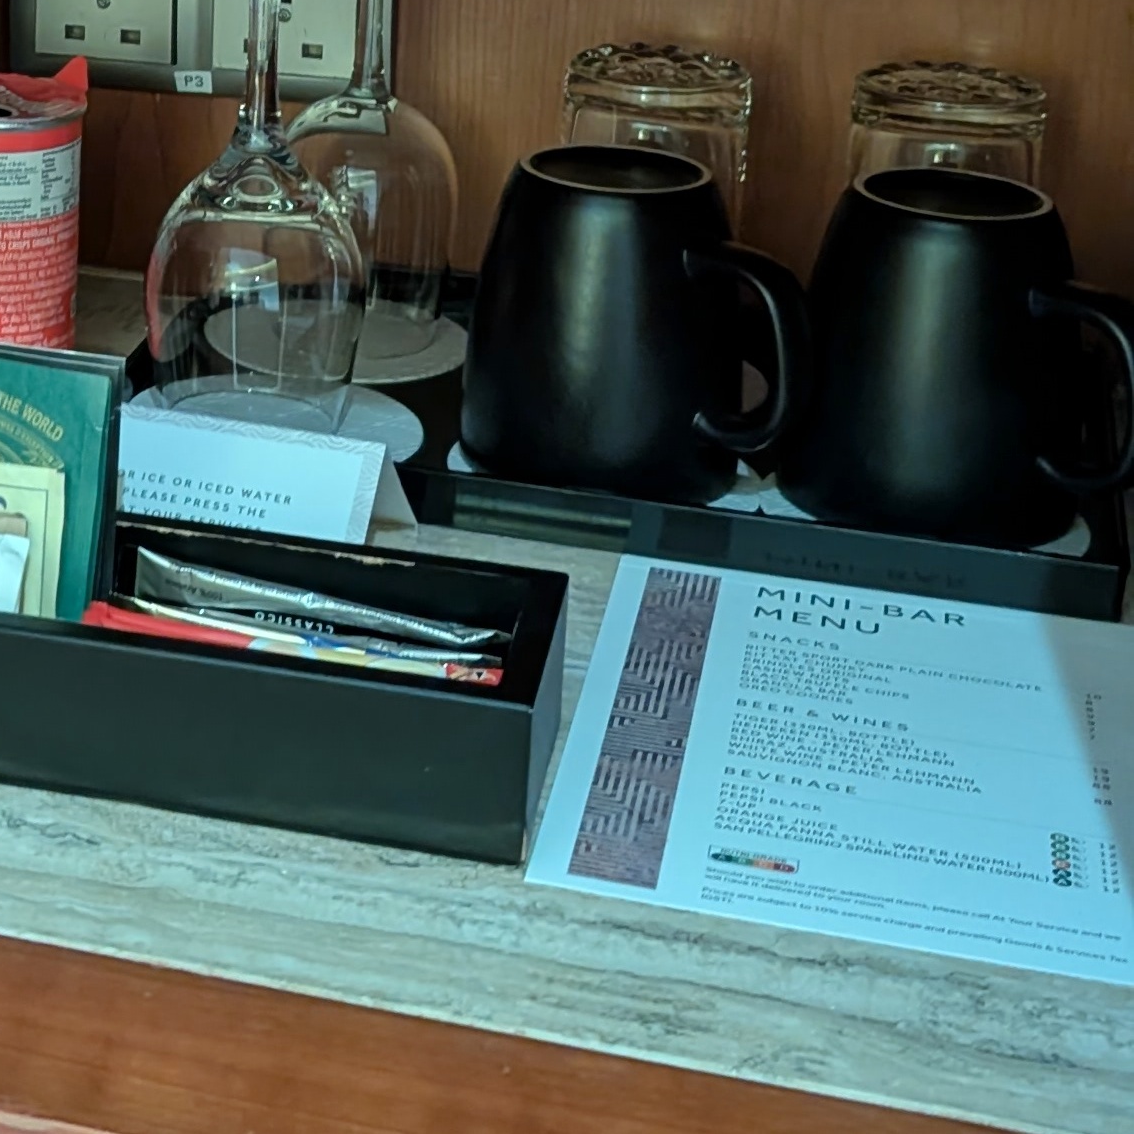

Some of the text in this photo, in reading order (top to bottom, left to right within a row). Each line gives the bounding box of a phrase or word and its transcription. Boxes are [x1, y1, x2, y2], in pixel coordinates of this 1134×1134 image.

[184, 75, 204, 88] P3
[21, 403, 64, 442] WORLD
[122, 487, 267, 519] PLEASE PRESS THE
[141, 472, 166, 485] ICE
[172, 476, 192, 489] OR
[198, 481, 235, 496] ICED
[241, 488, 292, 506] WATER
[753, 606, 880, 635] MENU
[756, 586, 965, 626] MINI-BAR
[254, 611, 335, 635] CLASSICO
[748, 630, 839, 650] SNACKS
[743, 656, 890, 683] PRINGLES ORIGINAL
[744, 650, 765, 658] KIT
[772, 654, 797, 663] KAT
[745, 644, 1042, 691] RITTER SPORT DARK PLAIN CHOCOLATE
[741, 669, 788, 682] BLACK
[864, 686, 909, 699] CHIPS
[742, 662, 849, 683] CASHEW NUTS
[738, 682, 852, 704] OREO COOKIES
[818, 686, 845, 696] BAR
[733, 712, 778, 725] TIGER
[736, 698, 794, 714] BEER
[831, 712, 908, 731] WINES
[731, 727, 954, 766] RED WINE PETER LEHMANN
[796, 744, 884, 763] AUSTRALIA
[727, 748, 822, 769] SAUVIGNON
[891, 773, 982, 794] AUSTRALIA
[728, 740, 974, 784] WHITE WINE PETER LEHMANN
[720, 781, 764, 794] PEPSI
[724, 766, 857, 795] BEVERAGE
[719, 790, 822, 812] PEPSI BLACK
[716, 805, 837, 831] ORANGE JUICE
[713, 821, 744, 833] SAN
[845, 842, 930, 863] SPARKLING
[934, 856, 985, 872] WATER
[779, 823, 834, 839] PANNA
[841, 833, 887, 847] STILL
[892, 841, 948, 857] WATER
